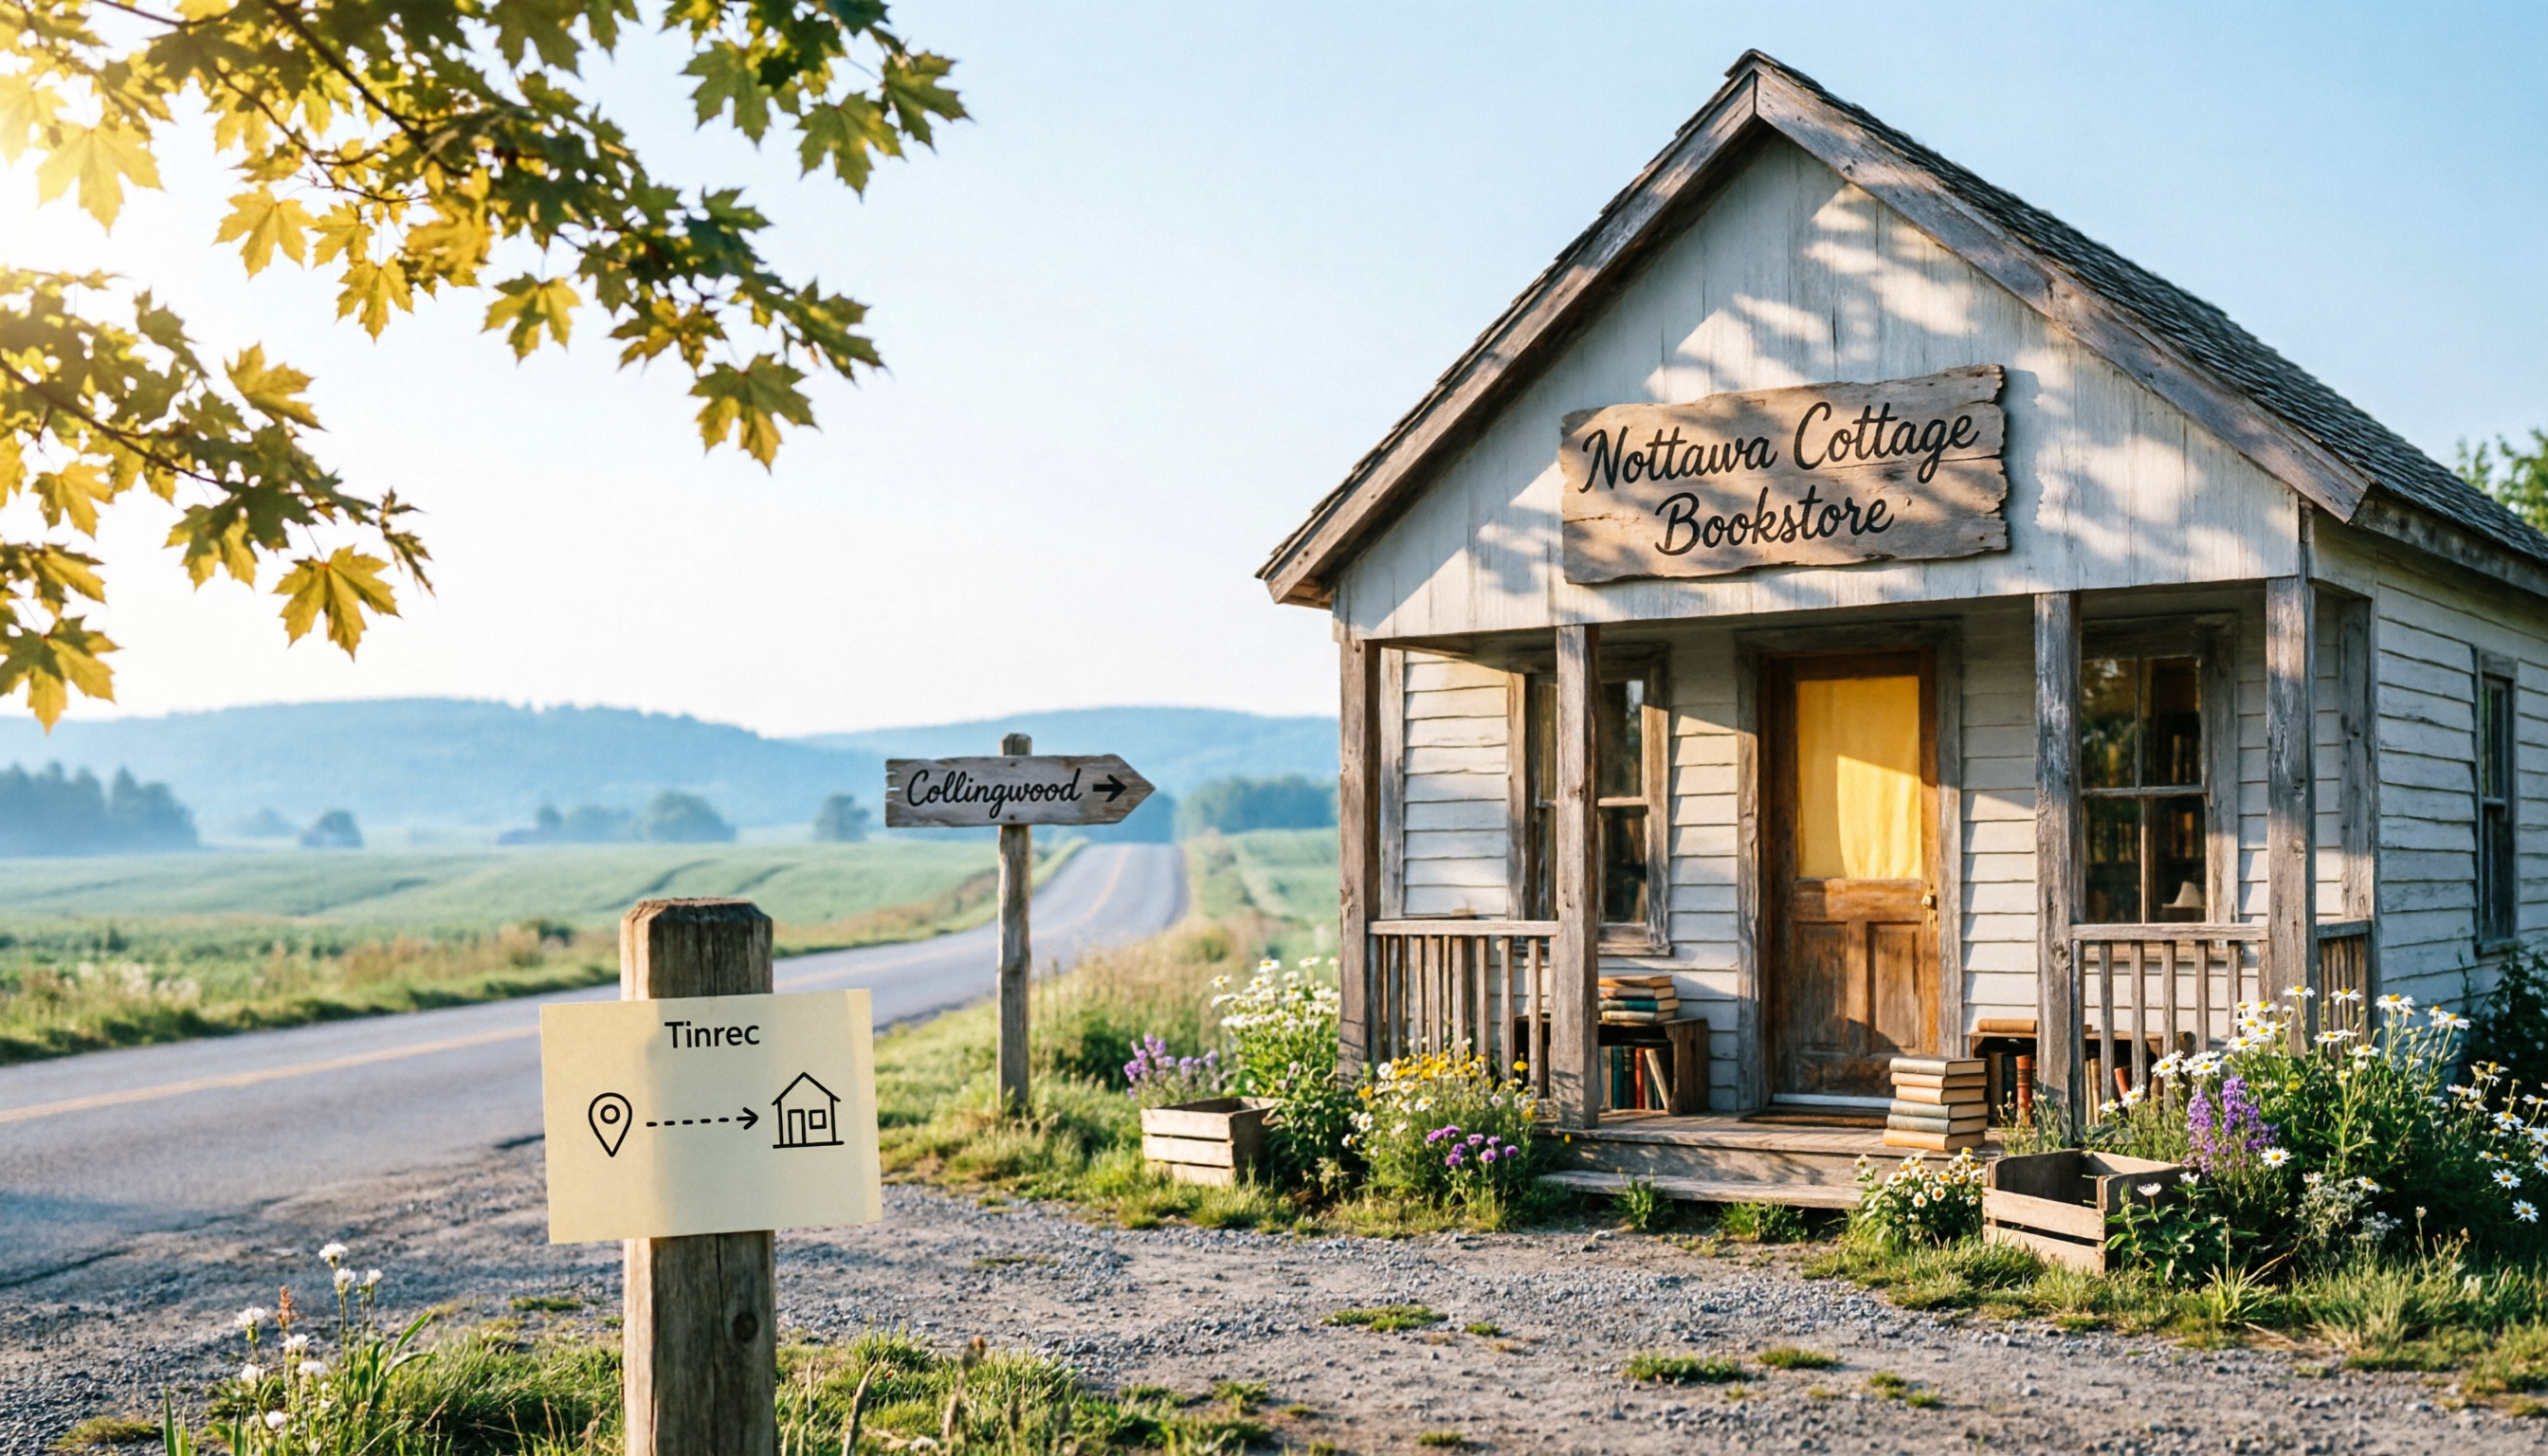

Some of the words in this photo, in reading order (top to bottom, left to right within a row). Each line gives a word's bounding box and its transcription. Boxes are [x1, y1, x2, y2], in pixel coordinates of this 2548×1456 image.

[1578, 425, 1778, 494] Nottawa
[1793, 400, 1980, 484] Cottage
[1654, 484, 1895, 556] Bookstore
[906, 767, 1083, 819] Collingwood
[664, 1021, 760, 1049] Tinrec
